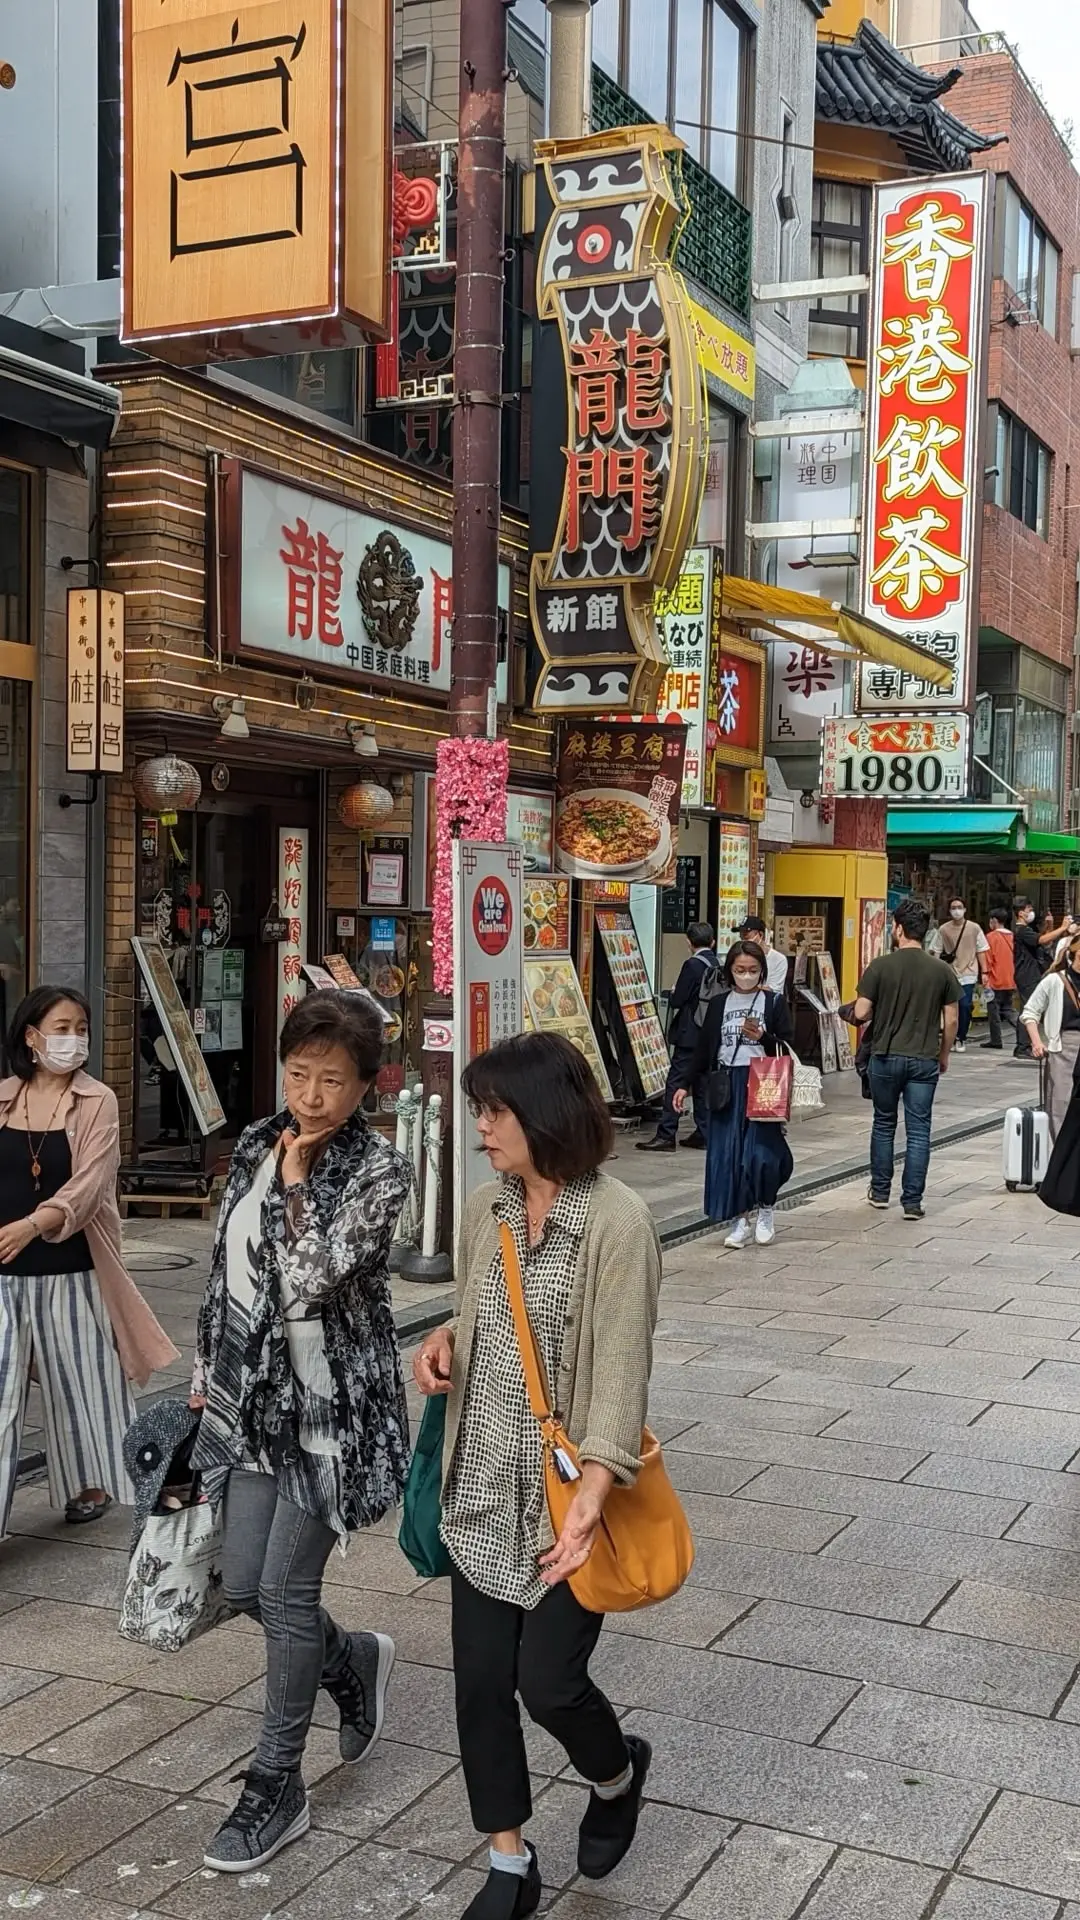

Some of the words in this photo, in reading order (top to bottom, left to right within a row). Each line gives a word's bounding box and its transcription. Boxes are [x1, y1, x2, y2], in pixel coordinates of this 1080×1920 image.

[167, 18, 306, 263] 宮
[873, 199, 976, 611] 香港飲茶
[560, 327, 670, 553] 龍門
[279, 516, 345, 647] 龍
[78, 595, 89, 647] 中華街
[108, 597, 117, 649] 中華街
[546, 593, 619, 634] 新館
[346, 642, 431, 684] 中国家庭料理
[670, 650, 702, 668] 連続
[782, 647, 836, 699] 楽
[70, 669, 95, 755] 桂宮
[102, 669, 122, 757] 桂宮
[856, 721, 958, 752] 食べ放題
[563, 731, 665, 763] 麻婆豆腐
[684, 761, 698, 779] 円
[481, 887, 505, 909] We
[484, 908, 502, 920] are
